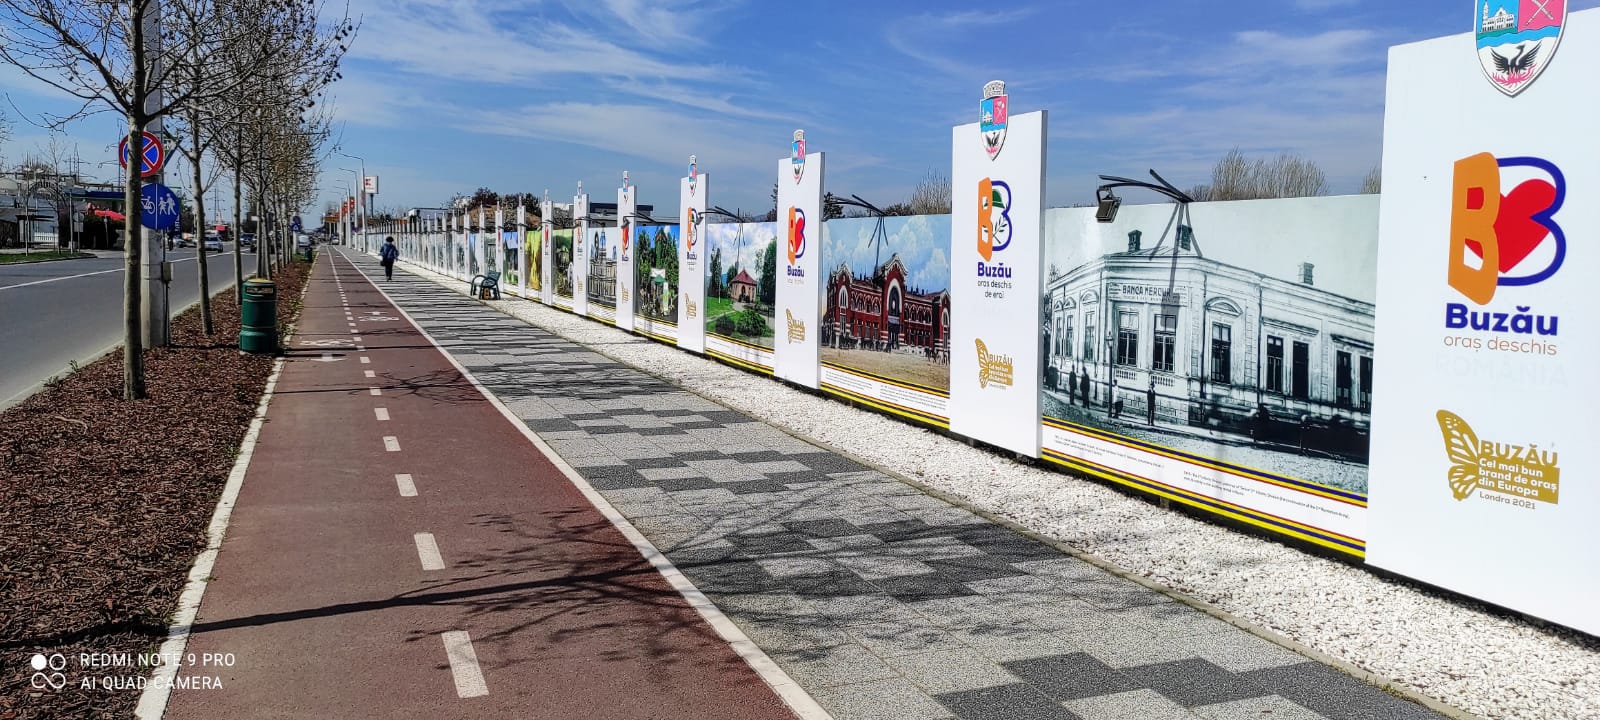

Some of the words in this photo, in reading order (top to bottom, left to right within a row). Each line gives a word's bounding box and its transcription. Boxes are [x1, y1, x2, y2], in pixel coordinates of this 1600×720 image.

[977, 261, 1012, 278] Buzău
[1445, 302, 1559, 336] Buzău
[1443, 335, 1482, 353] oraș
[1487, 336, 1558, 356] deschis
[1481, 440, 1558, 467] BUZĂU
[1478, 457, 1496, 468] Cel
[1498, 462, 1519, 473] mai
[1521, 465, 1543, 478] bun
[1478, 467, 1511, 481] brand
[1513, 474, 1528, 484] de
[1478, 477, 1495, 487] din
[1497, 480, 1539, 497] Europa
[1479, 491, 1511, 504] Londra
[1512, 498, 1536, 510] 2021
